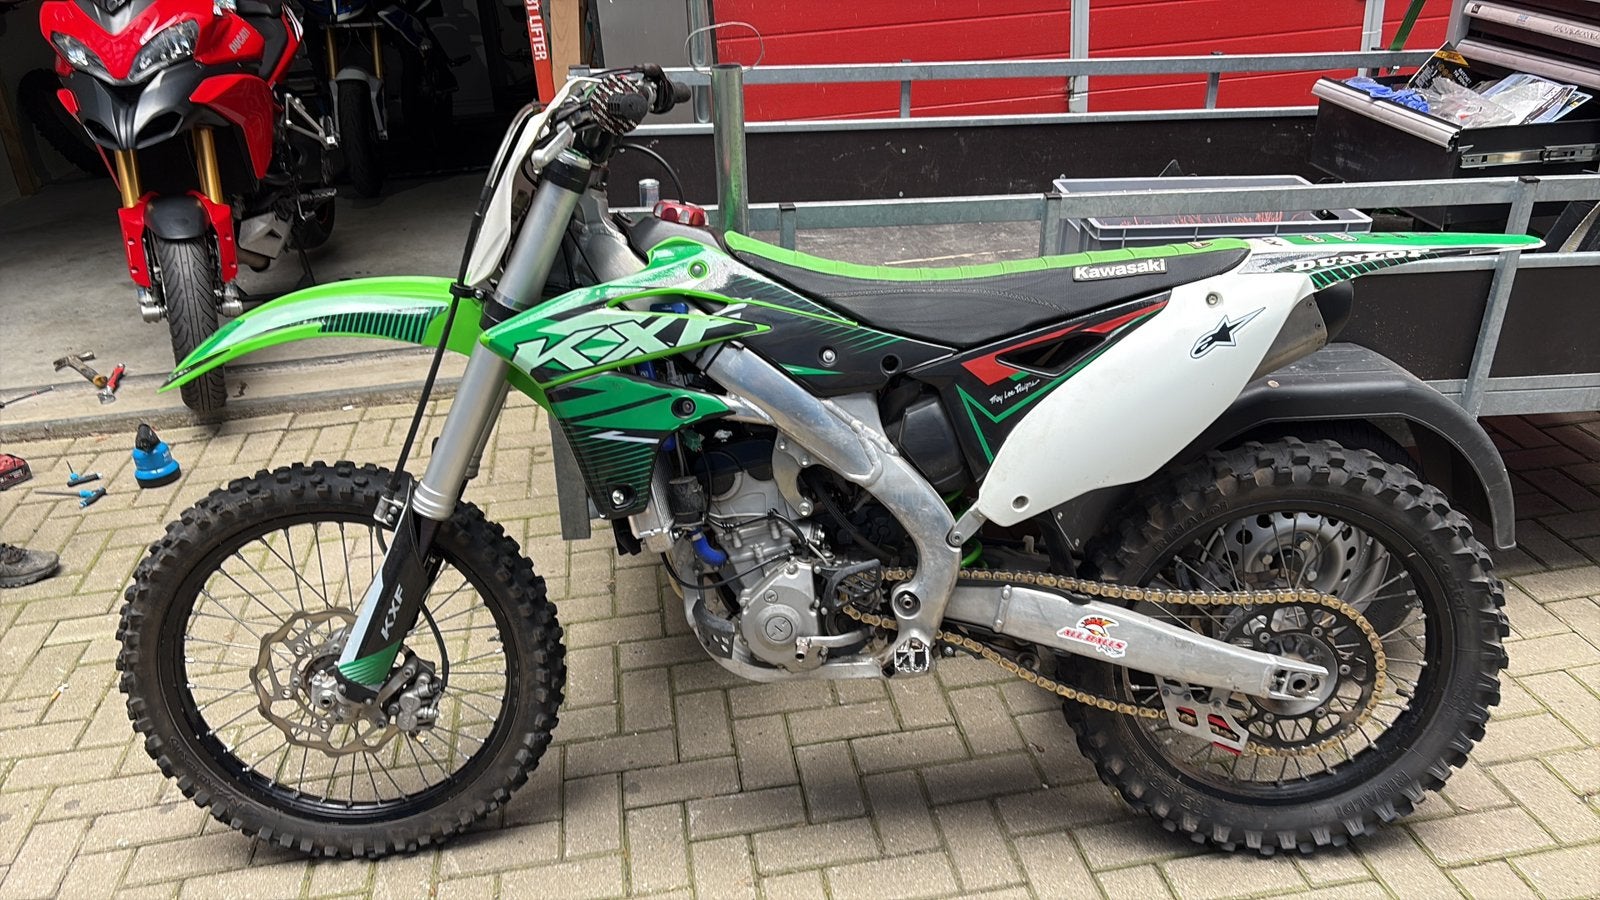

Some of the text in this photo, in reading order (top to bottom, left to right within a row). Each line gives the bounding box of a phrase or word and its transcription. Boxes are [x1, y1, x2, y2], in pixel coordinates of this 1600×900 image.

[229, 26, 250, 54] DUCATI
[529, 15, 548, 61] LIFTER
[1075, 258, 1166, 280] Kawasaki
[1293, 249, 1430, 272] DUNLOP
[512, 302, 746, 375] KXF
[1004, 390, 1015, 399] Lee
[380, 583, 403, 641] KXF
[1059, 628, 1126, 650] ALL BALLS
